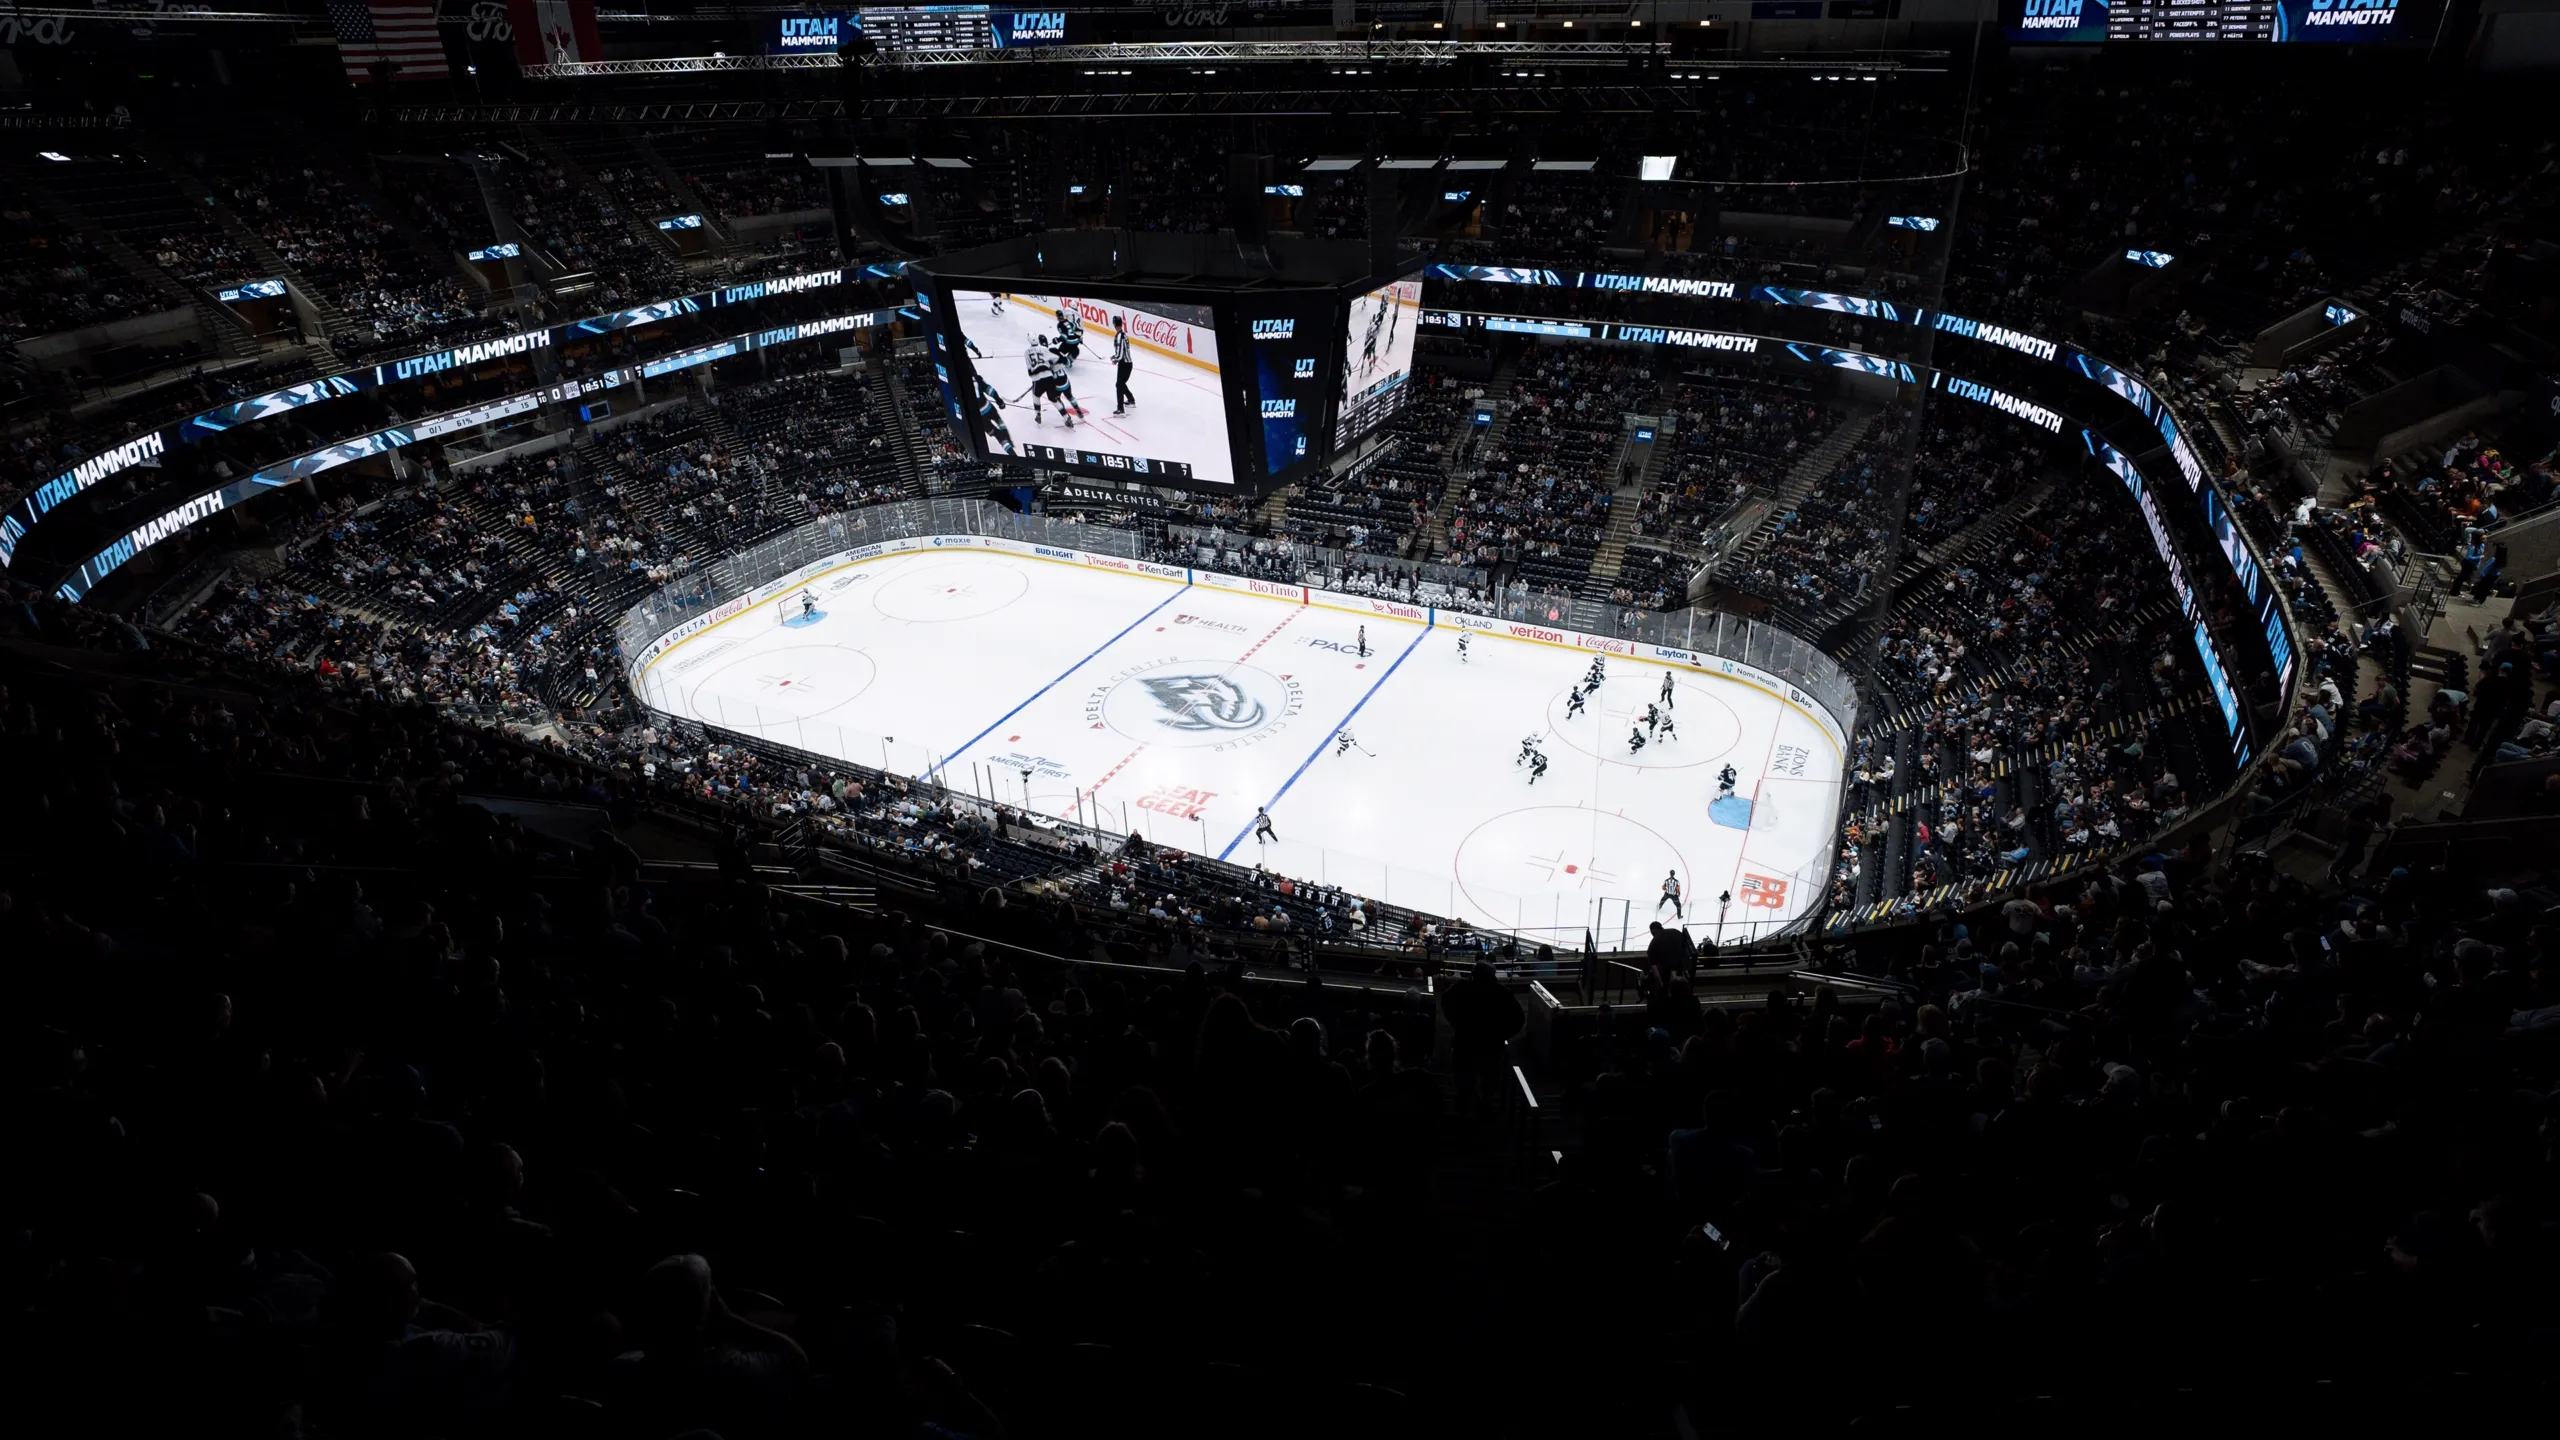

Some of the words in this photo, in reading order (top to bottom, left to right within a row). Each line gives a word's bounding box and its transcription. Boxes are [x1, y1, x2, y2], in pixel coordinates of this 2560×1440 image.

[1013, 13, 1065, 29] UTAH
[1165, 2, 1229, 27] Ford
[2022, 17, 2080, 28] MAMMOTH
[2305, 9, 2395, 25] MAMMOTH
[781, 18, 838, 35] UTAH
[1012, 29, 1064, 40] MAMMOTH
[781, 36, 837, 46] MAMMOTH
[726, 283, 764, 303] UTAH
[766, 270, 842, 295] MAMMOTH
[1595, 274, 1644, 290] UTAH
[1642, 277, 1735, 298] MAMMOTH
[1252, 319, 1294, 332] UTAH
[1425, 316, 1446, 325] 18:51
[1467, 316, 1471, 326] 1
[759, 326, 796, 347] UTAH
[799, 312, 874, 338] MAMMOTH
[1253, 331, 1293, 340] MAMMOTH
[1619, 327, 1665, 343] UTAH
[1666, 330, 1758, 353] MAMMOTH
[1976, 323, 2057, 361] MAMMOTH
[397, 351, 451, 379] UTAH
[454, 329, 550, 366] MAMMOTH
[1029, 353, 1045, 367] 55
[1296, 359, 1315, 371] UT
[624, 369, 630, 380] 1
[552, 388, 561, 400] 0
[580, 379, 605, 393] 18:51
[521, 401, 529, 409] 15
[1948, 377, 1992, 404] UTAH
[1990, 390, 2063, 434] MAMMOTH
[429, 426, 442, 435] 0/1
[456, 418, 473, 427] 61%
[1046, 448, 1054, 459] 0
[1086, 455, 1097, 463] 2ND
[1354, 455, 1373, 477] DELTA
[1373, 441, 1394, 461] CENTER
[2160, 412, 2177, 449] UTAH
[2171, 431, 2202, 493] MAMMOTH
[1102, 455, 1130, 469] 18:51
[1160, 462, 1166, 473] 1
[35, 472, 77, 513] UTAH
[73, 431, 164, 490] MAMMOTH
[1074, 488, 1112, 501] DELTA
[1116, 495, 1159, 507] CENTER
[94, 534, 134, 577] UTAH
[132, 490, 224, 551] MAMMOTH
[845, 544, 882, 557] AMERICAN
[851, 550, 884, 561] EXPRESS
[1035, 547, 1053, 558] BUD
[1053, 550, 1074, 560] LIGHT
[1145, 564, 1162, 576] Ken
[1163, 567, 1183, 579] Garff
[1250, 580, 1268, 593] Rio
[1268, 583, 1298, 598] Tinto
[1387, 603, 1422, 620] Smith's
[672, 619, 706, 641] DELTA
[1199, 620, 1248, 634] HEALTH
[1454, 616, 1492, 630] OKLAND
[1509, 625, 1563, 643] verizon
[2266, 609, 2290, 677] UTAH
[1656, 647, 1688, 659] Layton
[1737, 668, 1756, 682] Nomi
[1755, 673, 1778, 689] Health
[1086, 685, 1110, 721] DELTA
[1111, 655, 1179, 683] CENTER
[1285, 681, 1303, 717] DELTA
[1215, 721, 1287, 753] CENTER
[1772, 744, 1794, 773] BANK
[1790, 747, 1810, 777] ZIONS
[988, 755, 1035, 771] AMERICA
[1036, 767, 1071, 779] FIRST
[1136, 795, 1207, 821] GEEK
